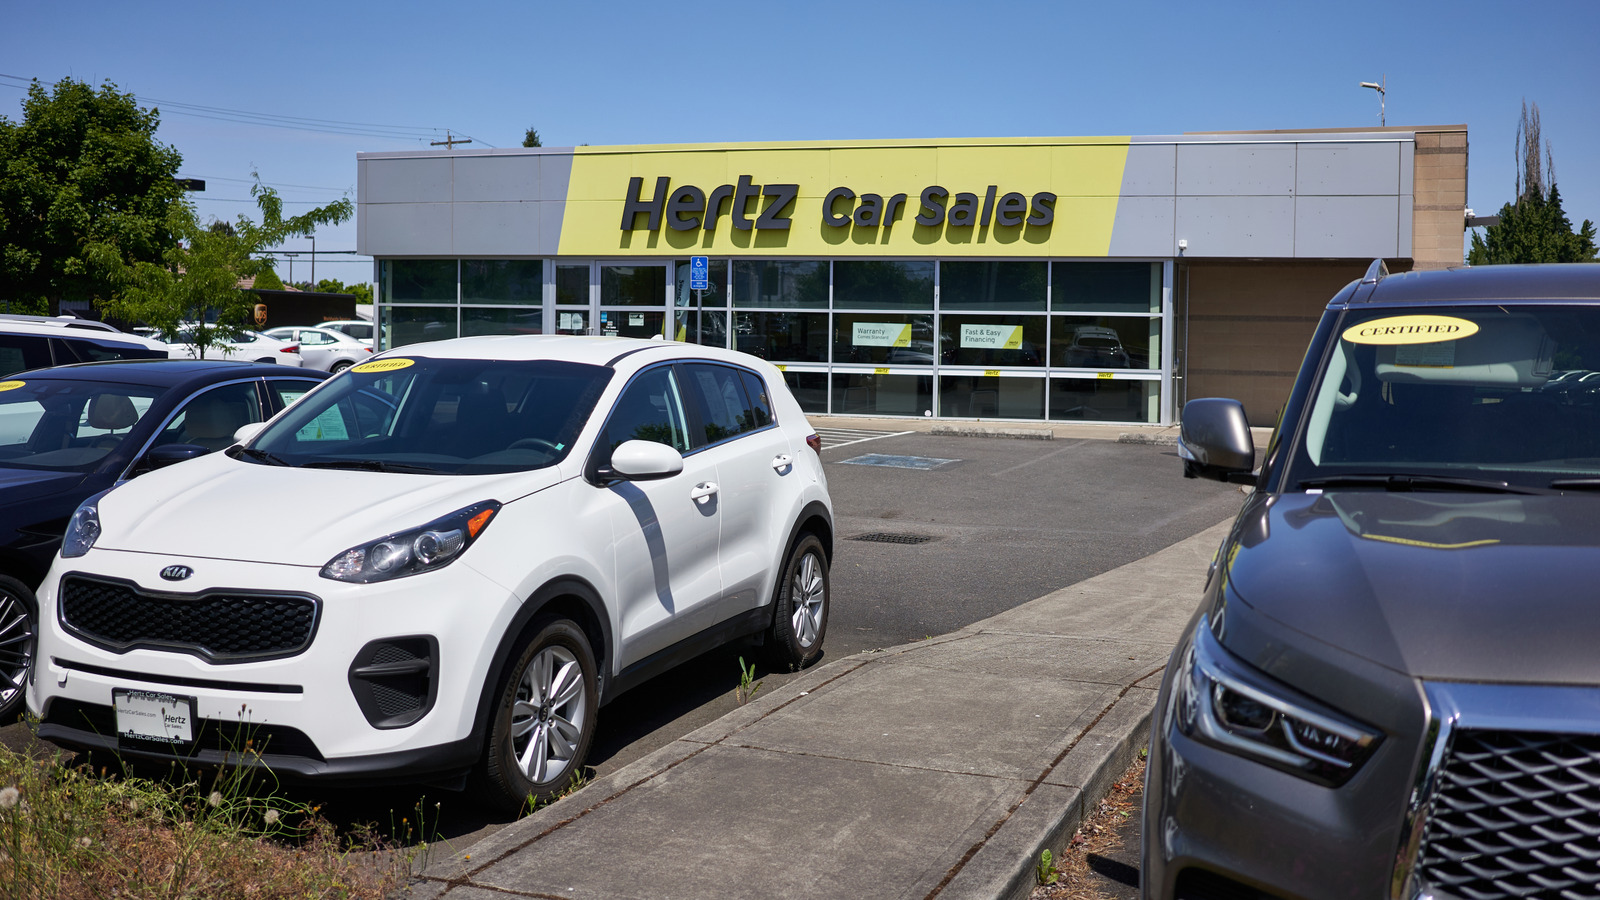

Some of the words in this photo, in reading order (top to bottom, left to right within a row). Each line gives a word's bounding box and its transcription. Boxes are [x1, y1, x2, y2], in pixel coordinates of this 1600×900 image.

[619, 174, 800, 232] Hertz
[821, 186, 908, 229] Car
[914, 185, 1058, 229] Sales
[857, 328, 886, 336] Warranty
[1360, 325, 1460, 337] CERTIFIED
[965, 336, 996, 344] Financing
[163, 566, 187, 578] KIA
[504, 656, 525, 709] KUMHO
[117, 708, 157, 718] HertzCarSales.com
[164, 714, 186, 724] Hertz
[124, 732, 184, 745] HertzCarSales.com
